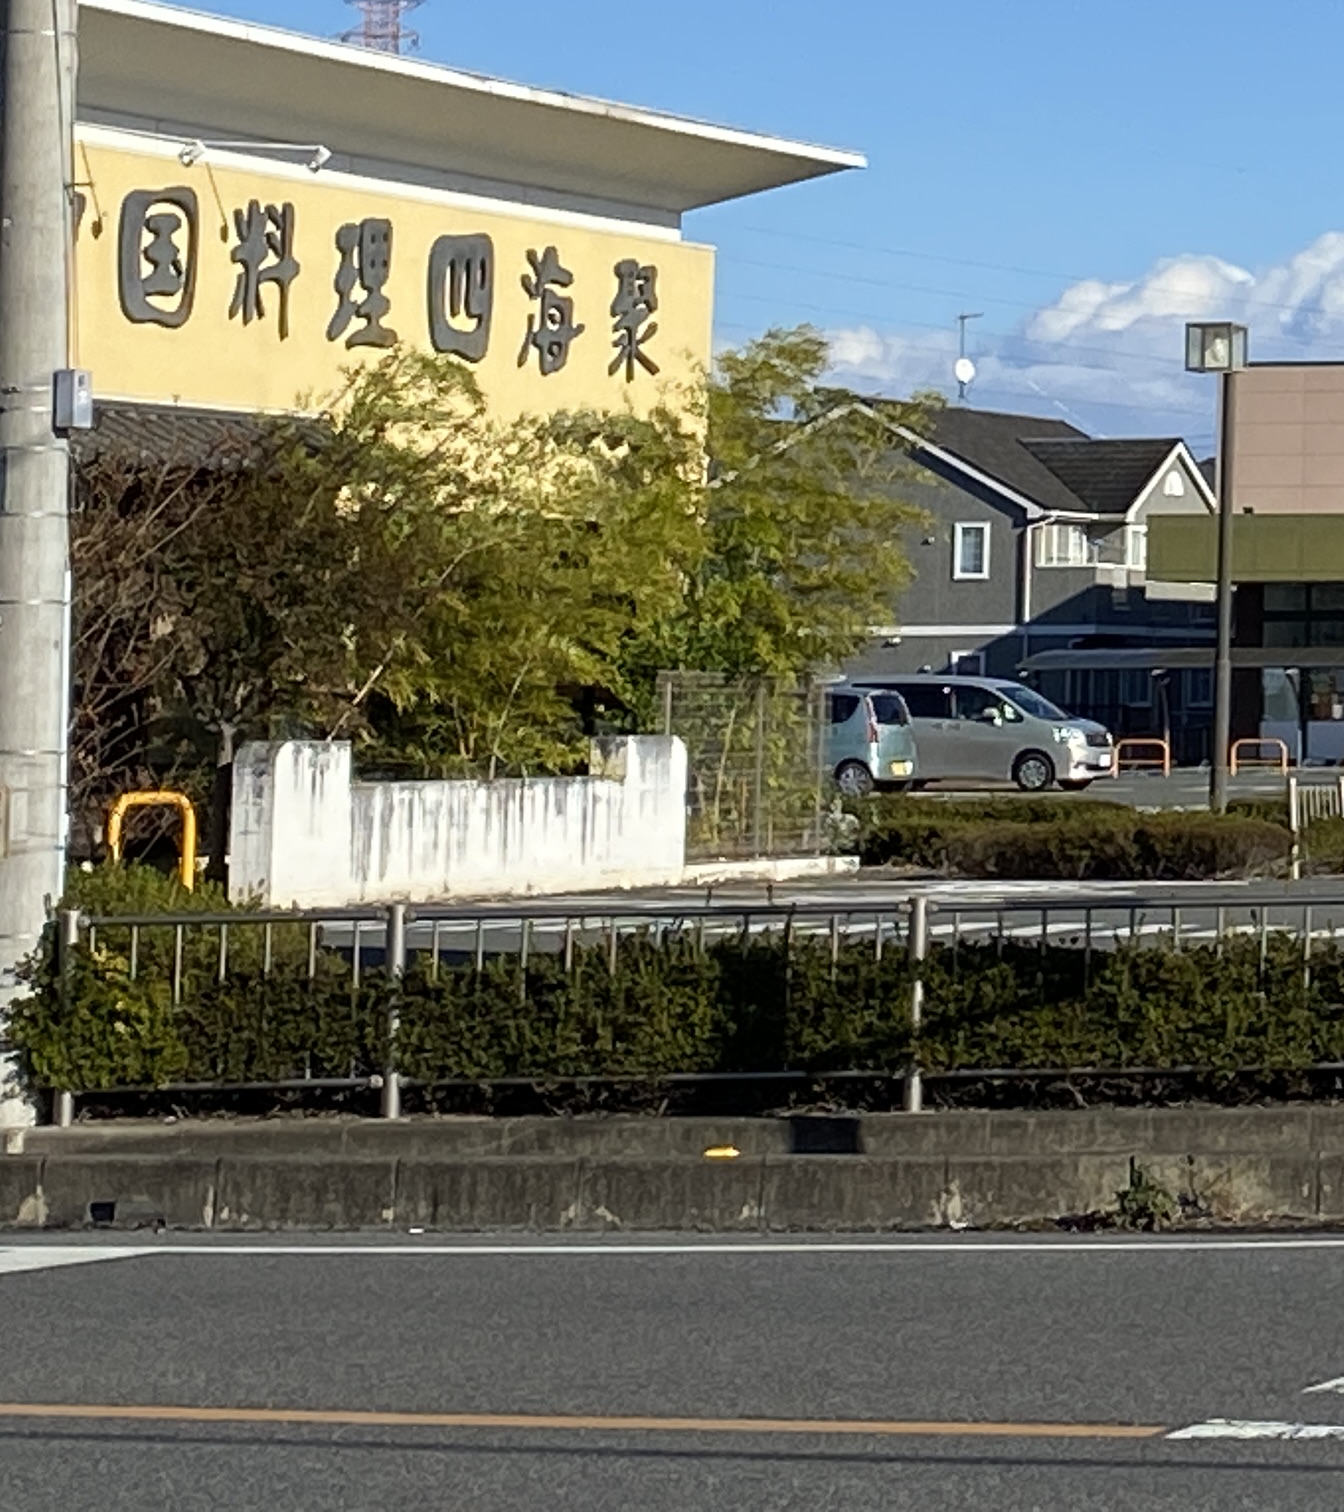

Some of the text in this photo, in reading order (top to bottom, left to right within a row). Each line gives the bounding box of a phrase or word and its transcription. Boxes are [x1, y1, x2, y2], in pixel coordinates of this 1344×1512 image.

[74, 186, 662, 381] 国料理四海聚
